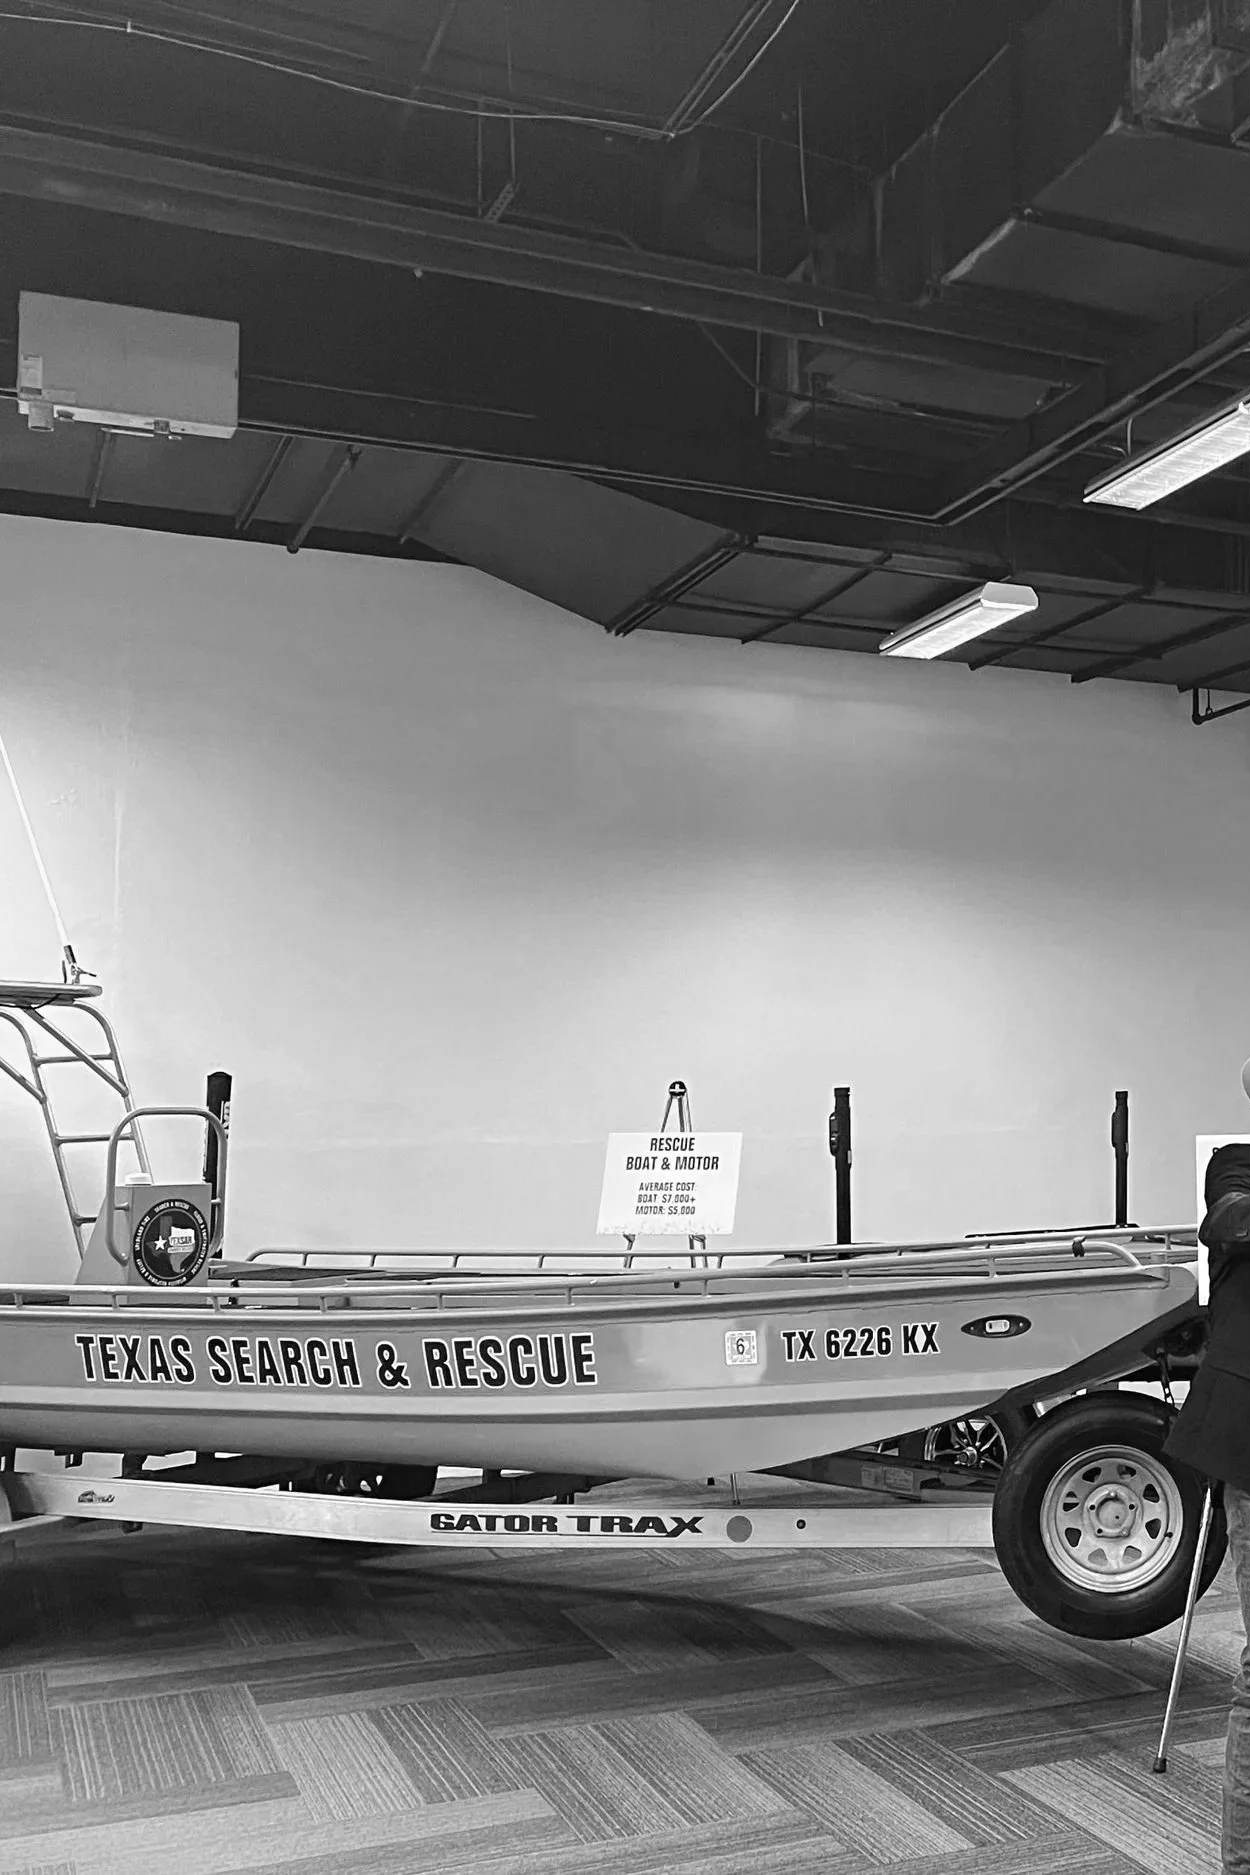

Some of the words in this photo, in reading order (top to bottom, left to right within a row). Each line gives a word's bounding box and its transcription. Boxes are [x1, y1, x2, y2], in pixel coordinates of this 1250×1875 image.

[650, 1137, 696, 1151] RESCUE
[626, 1156, 658, 1170] BOAT
[661, 1157, 671, 1170] &
[675, 1156, 719, 1170] MOTOR
[639, 1182, 674, 1191] AVERAGE
[637, 1194, 660, 1203] BOAT:
[662, 1194, 696, 1204] $7,000+
[635, 1206, 666, 1215] MOTOR:
[668, 1206, 696, 1216] $5,000
[736, 1337, 745, 1355] 6
[781, 1329, 818, 1362] TX
[825, 1325, 893, 1360] 6226
[901, 1321, 941, 1355] KX
[75, 1334, 196, 1385] TEXAS
[206, 1335, 362, 1388] SEARCH
[376, 1341, 411, 1389] &
[422, 1332, 598, 1389] RESCUE
[430, 1513, 559, 1532] GATOR
[566, 1515, 704, 1537] TRAX
